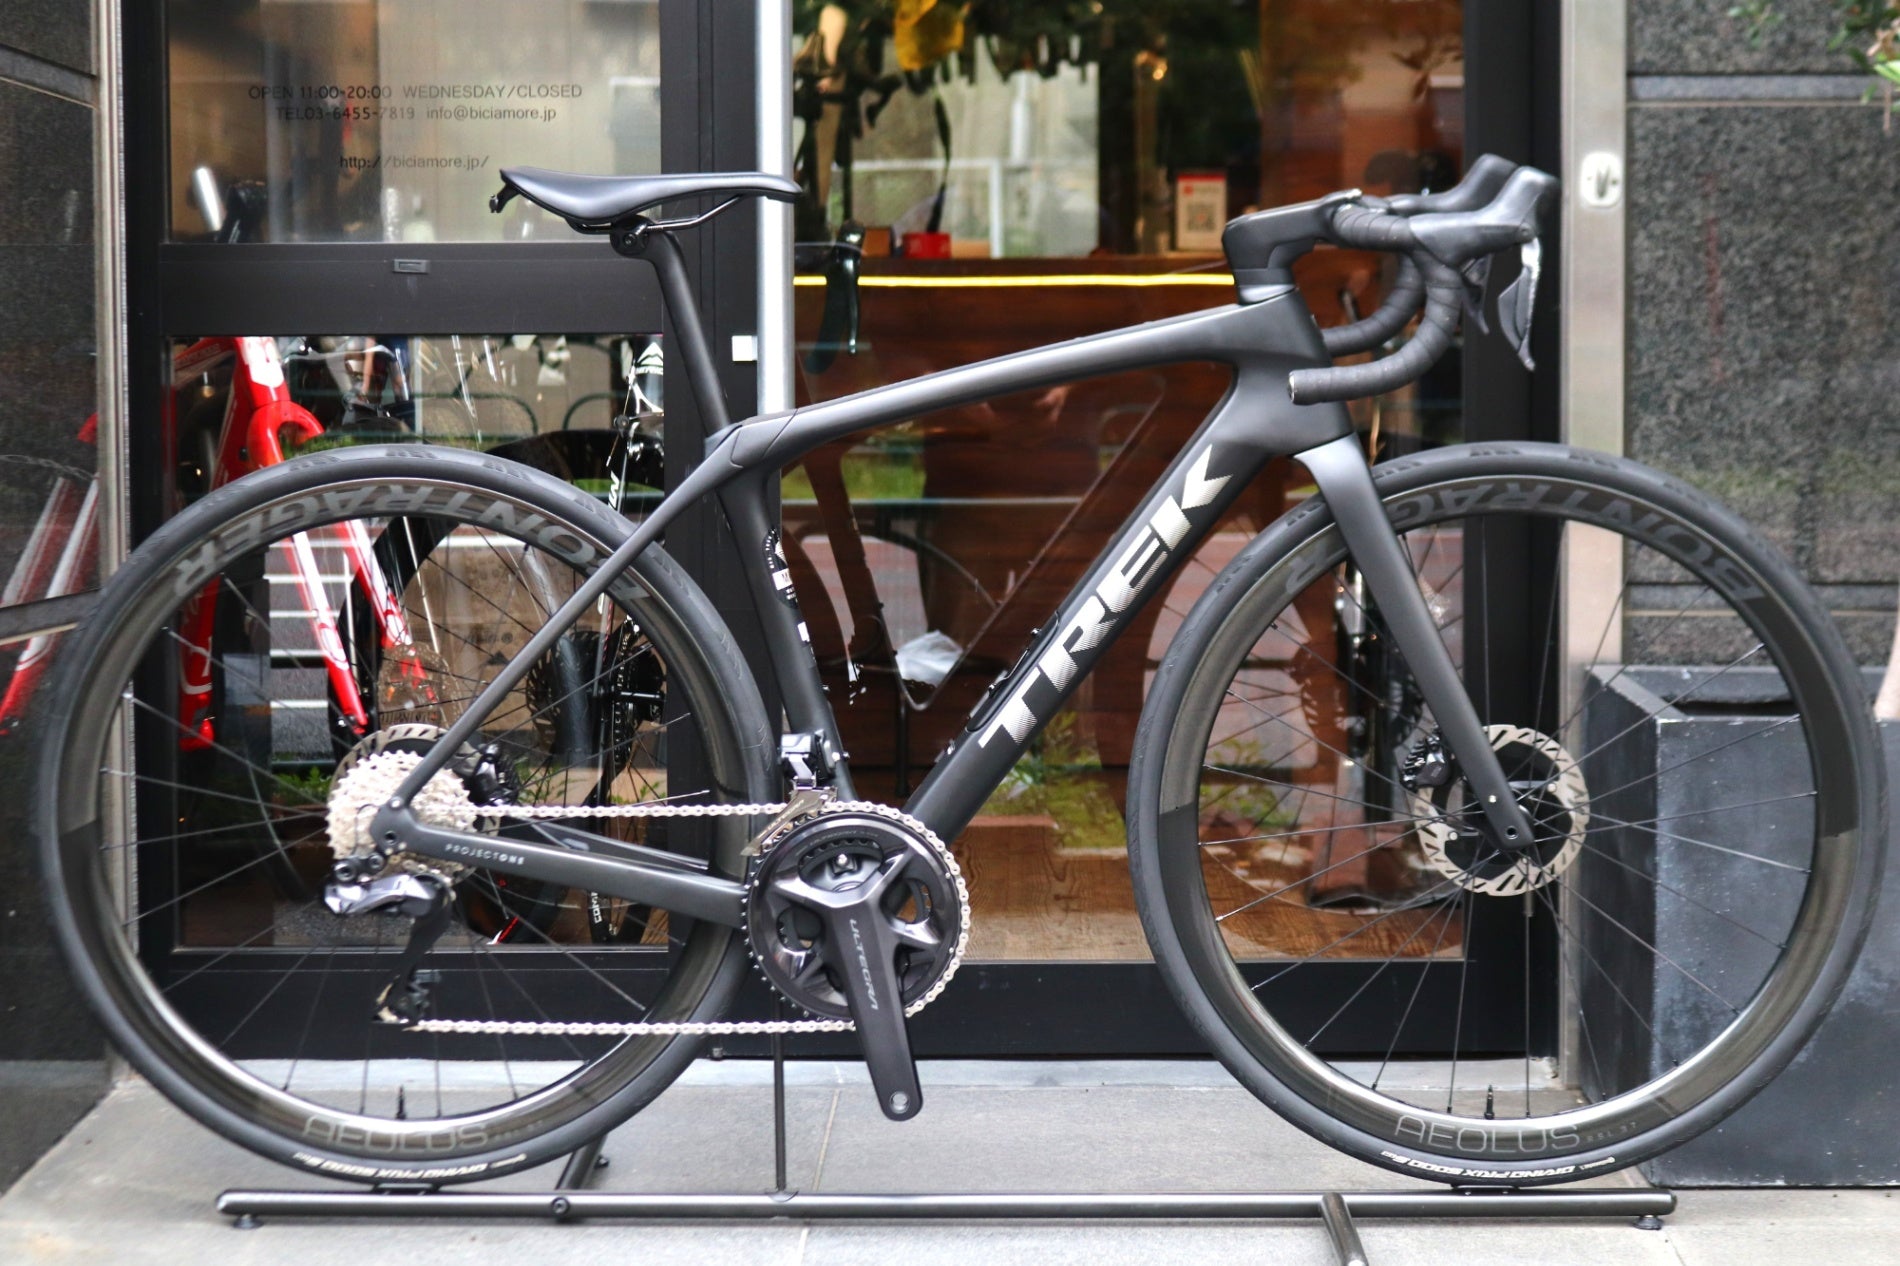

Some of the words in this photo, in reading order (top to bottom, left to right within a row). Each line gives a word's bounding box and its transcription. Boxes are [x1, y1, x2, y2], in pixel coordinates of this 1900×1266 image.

[248, 85, 294, 100] OPEN
[300, 85, 392, 99] 11:00-20:00
[402, 84, 583, 99] WEDNESDAY/CLOSED
[426, 105, 557, 122] info@biciamore.jp
[340, 154, 490, 171] http://biciamore.jp/
[1284, 481, 1767, 602] BONTRAGR
[977, 443, 1234, 749] TREK
[849, 918, 880, 1011] ULTEGRA
[302, 1113, 489, 1153] AEOLUS
[1394, 1113, 1581, 1154] AEOLUS
[1407, 1158, 1463, 1176] 5000
[1461, 1168, 1512, 1179] PRIX
